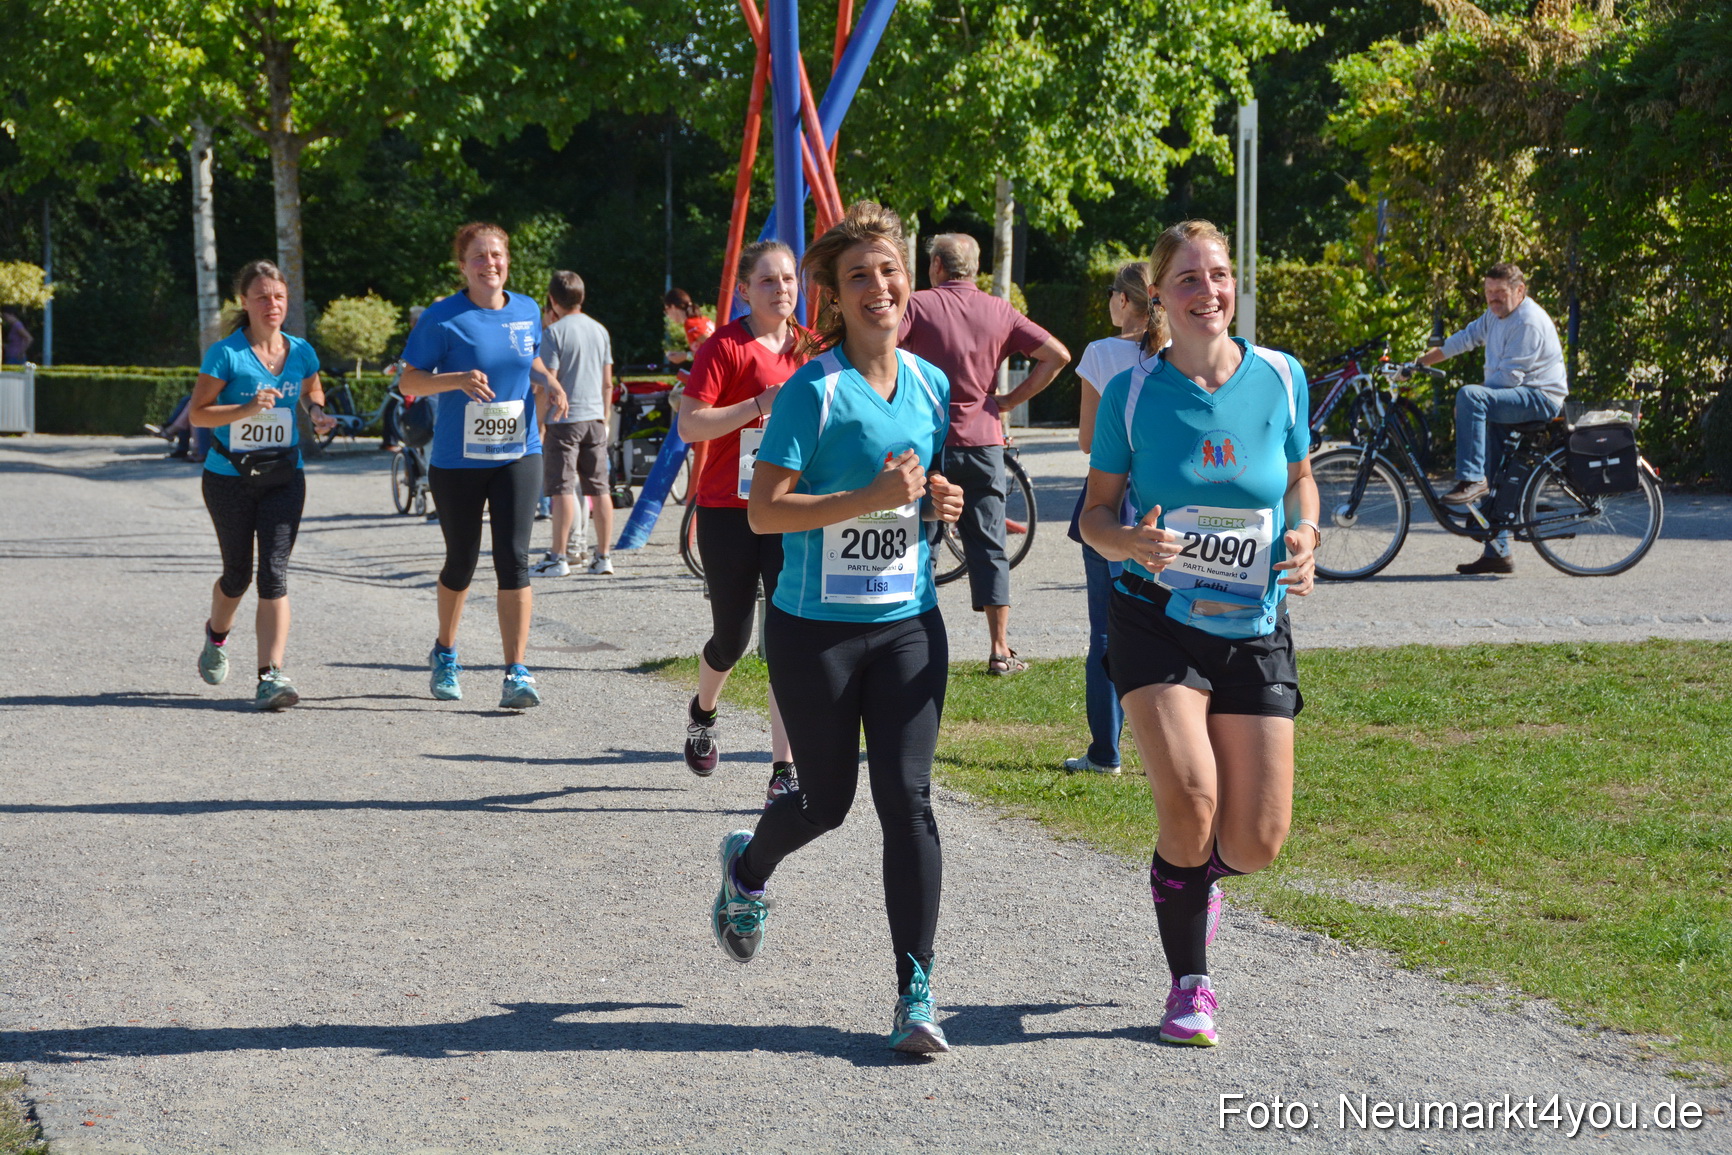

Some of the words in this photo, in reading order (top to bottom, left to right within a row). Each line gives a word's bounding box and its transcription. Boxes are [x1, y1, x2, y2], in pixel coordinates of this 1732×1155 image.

[241, 424, 284, 443] 2010
[474, 418, 517, 436] 2999
[485, 445, 505, 454] Birgit
[1198, 516, 1246, 529] BOCK
[841, 528, 907, 560] 2083
[1179, 531, 1257, 568] 2090
[1183, 562, 1205, 572] PARTL
[1207, 567, 1238, 578] Neumarkt
[866, 579, 888, 592] Lisa
